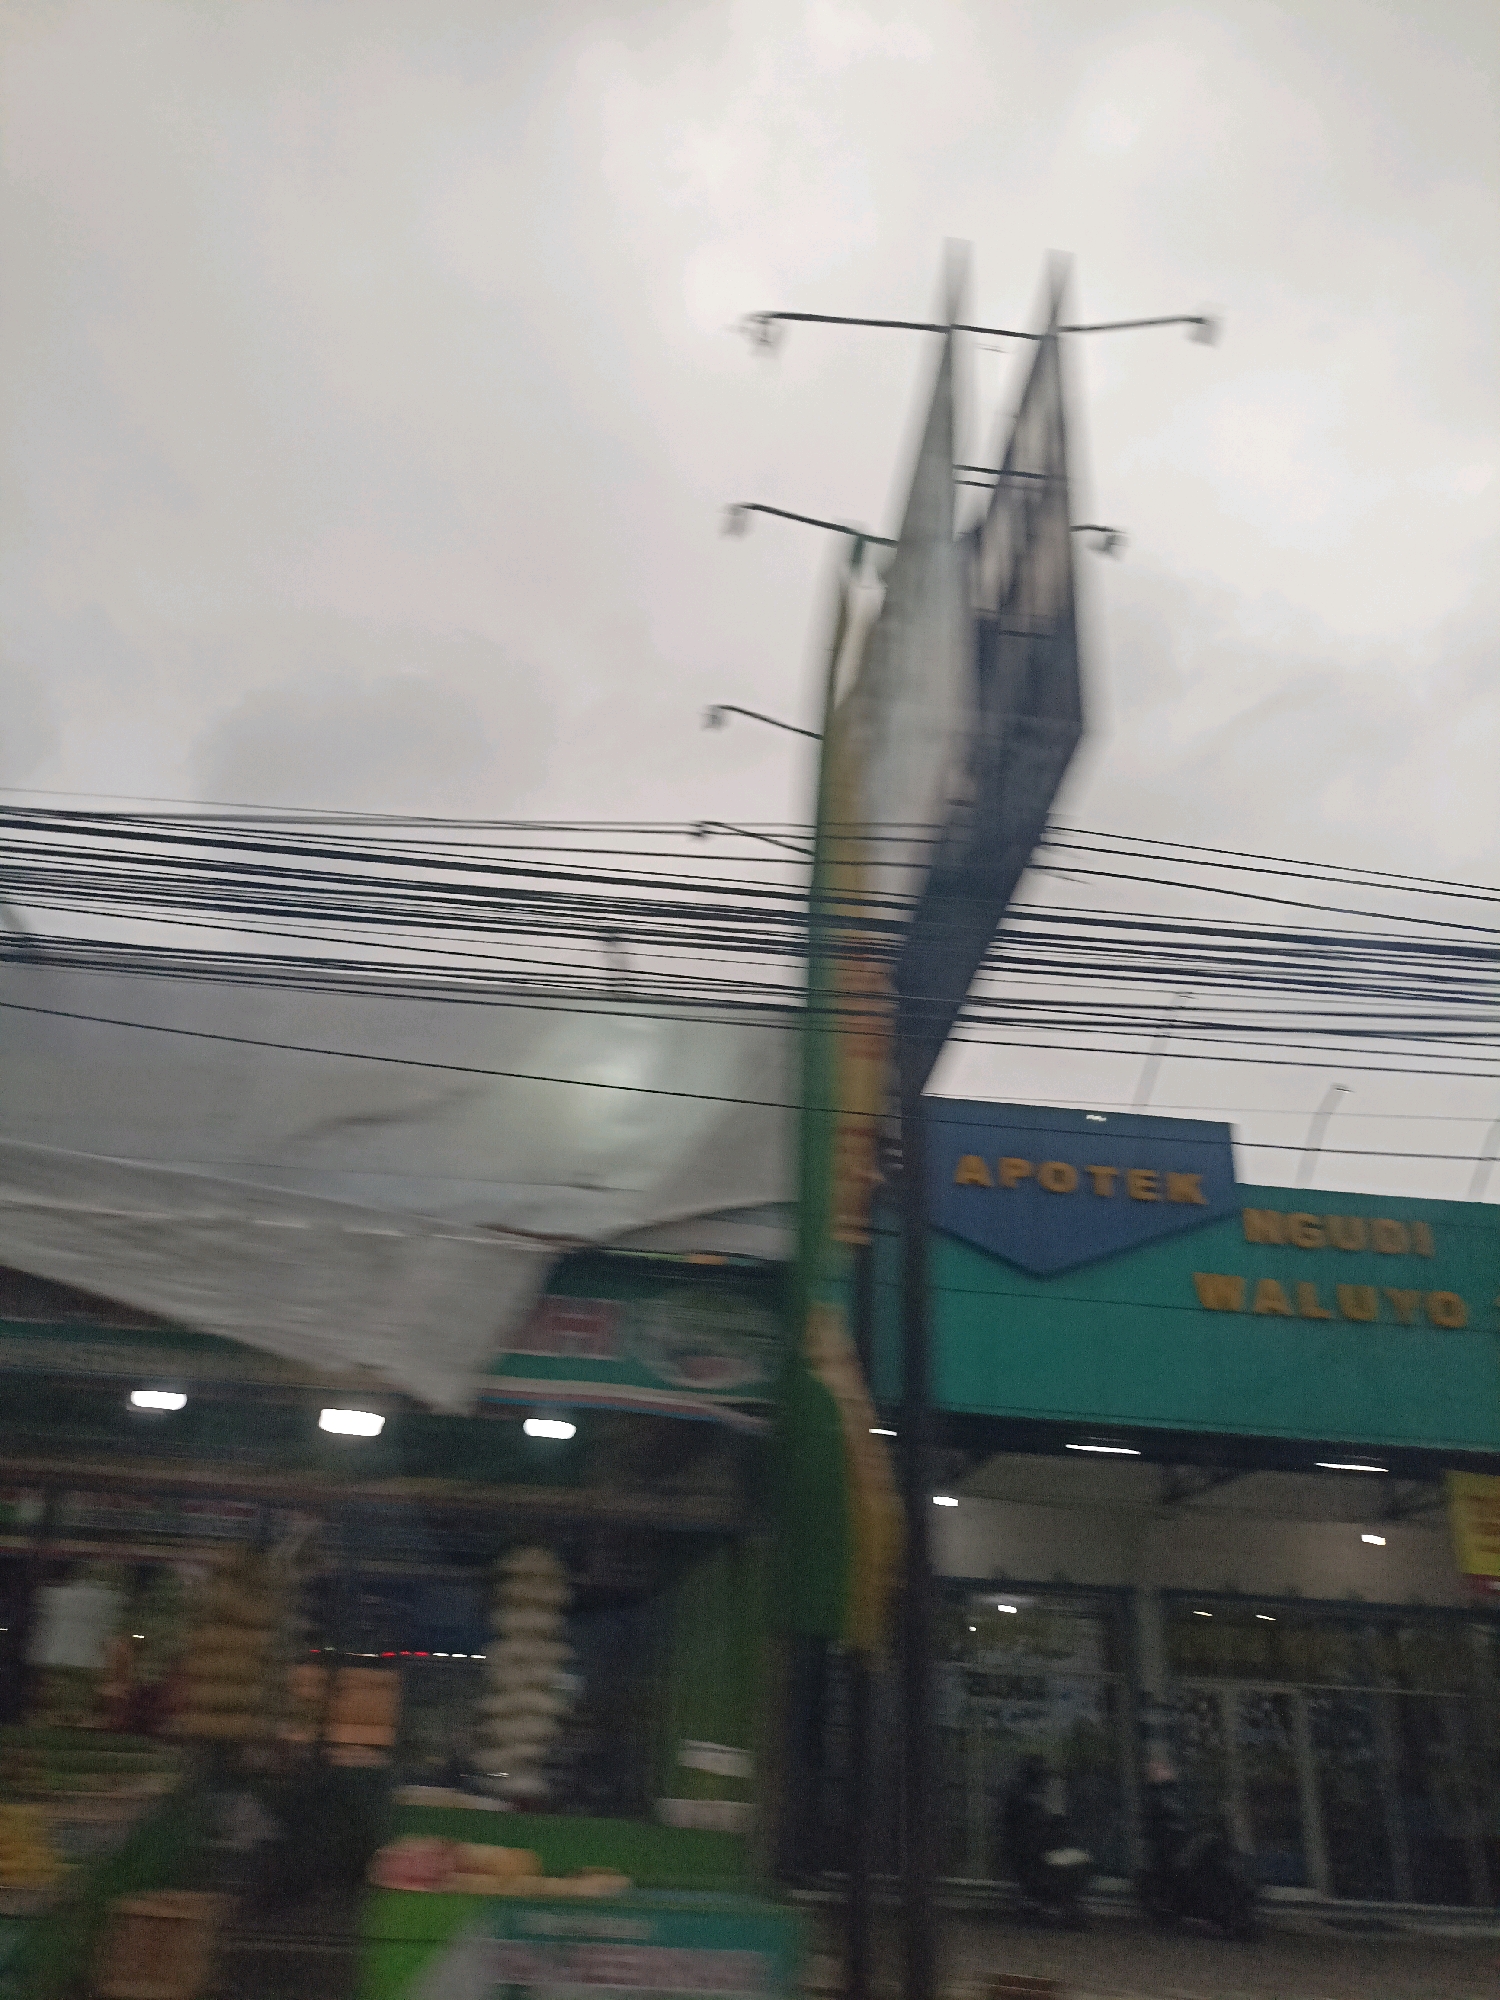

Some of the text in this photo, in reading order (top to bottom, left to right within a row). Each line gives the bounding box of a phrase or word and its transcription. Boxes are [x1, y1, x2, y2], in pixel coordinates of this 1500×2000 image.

[955, 1154, 1208, 1205] APOTEK
[1242, 1208, 1434, 1258] NGUDI
[1192, 1272, 1467, 1328] WALUYO
